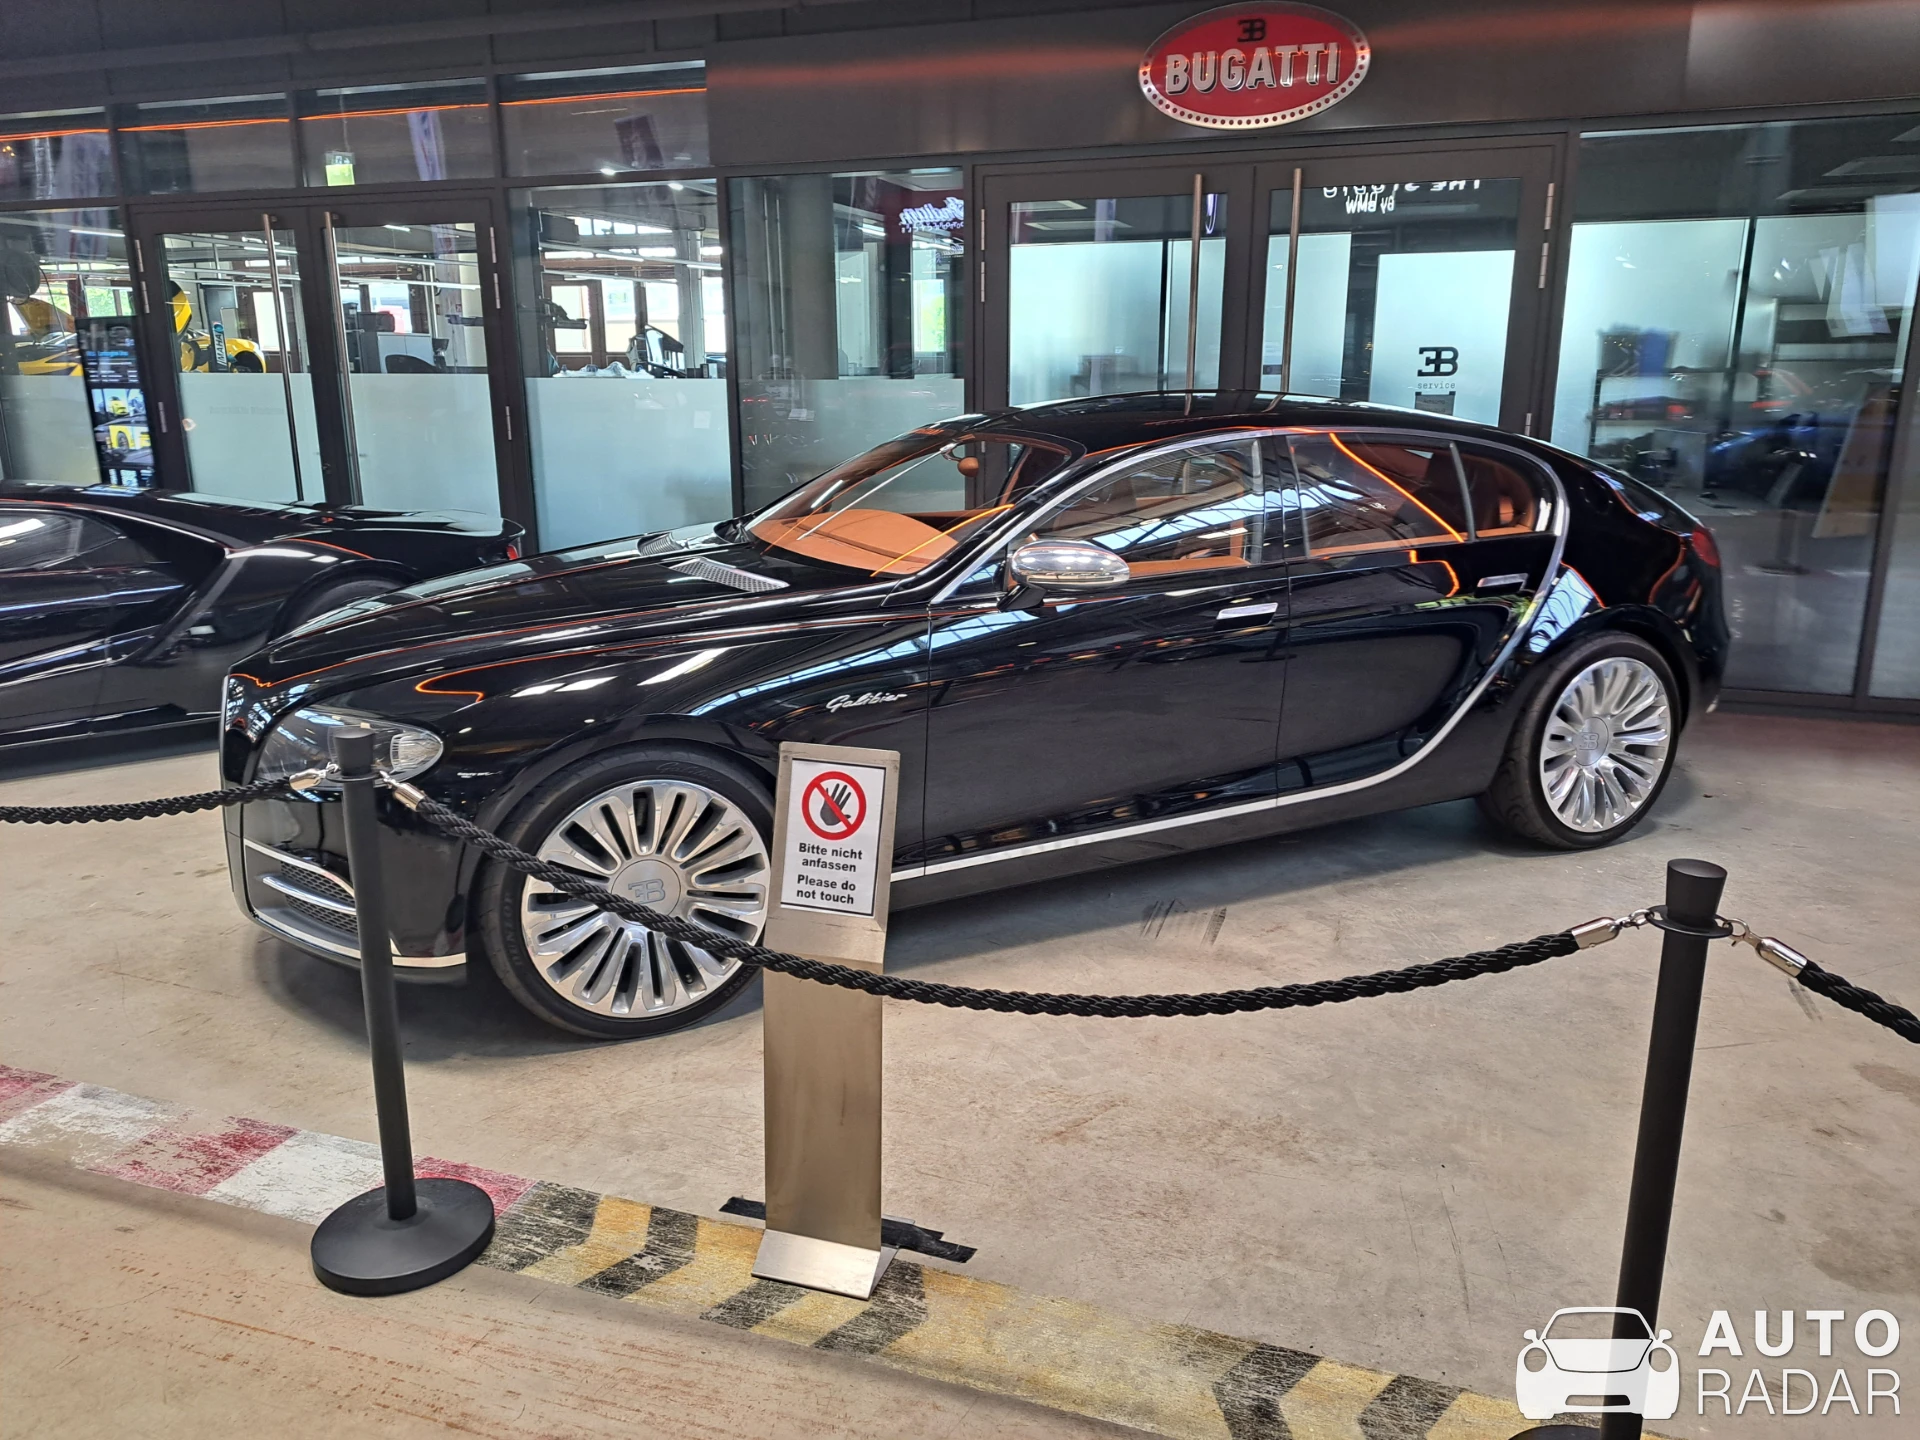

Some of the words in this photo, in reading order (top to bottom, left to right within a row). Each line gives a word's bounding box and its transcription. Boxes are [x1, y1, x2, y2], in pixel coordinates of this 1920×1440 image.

[1165, 42, 1342, 96] BUGATTI
[1417, 381, 1456, 390] service
[825, 692, 908, 713] Galibier
[798, 842, 827, 856] Bitte
[831, 847, 863, 860] nicht
[801, 857, 857, 873] anfassen
[796, 873, 838, 889] Please
[840, 880, 857, 891] do
[795, 889, 817, 900] not
[819, 891, 855, 905] touch
